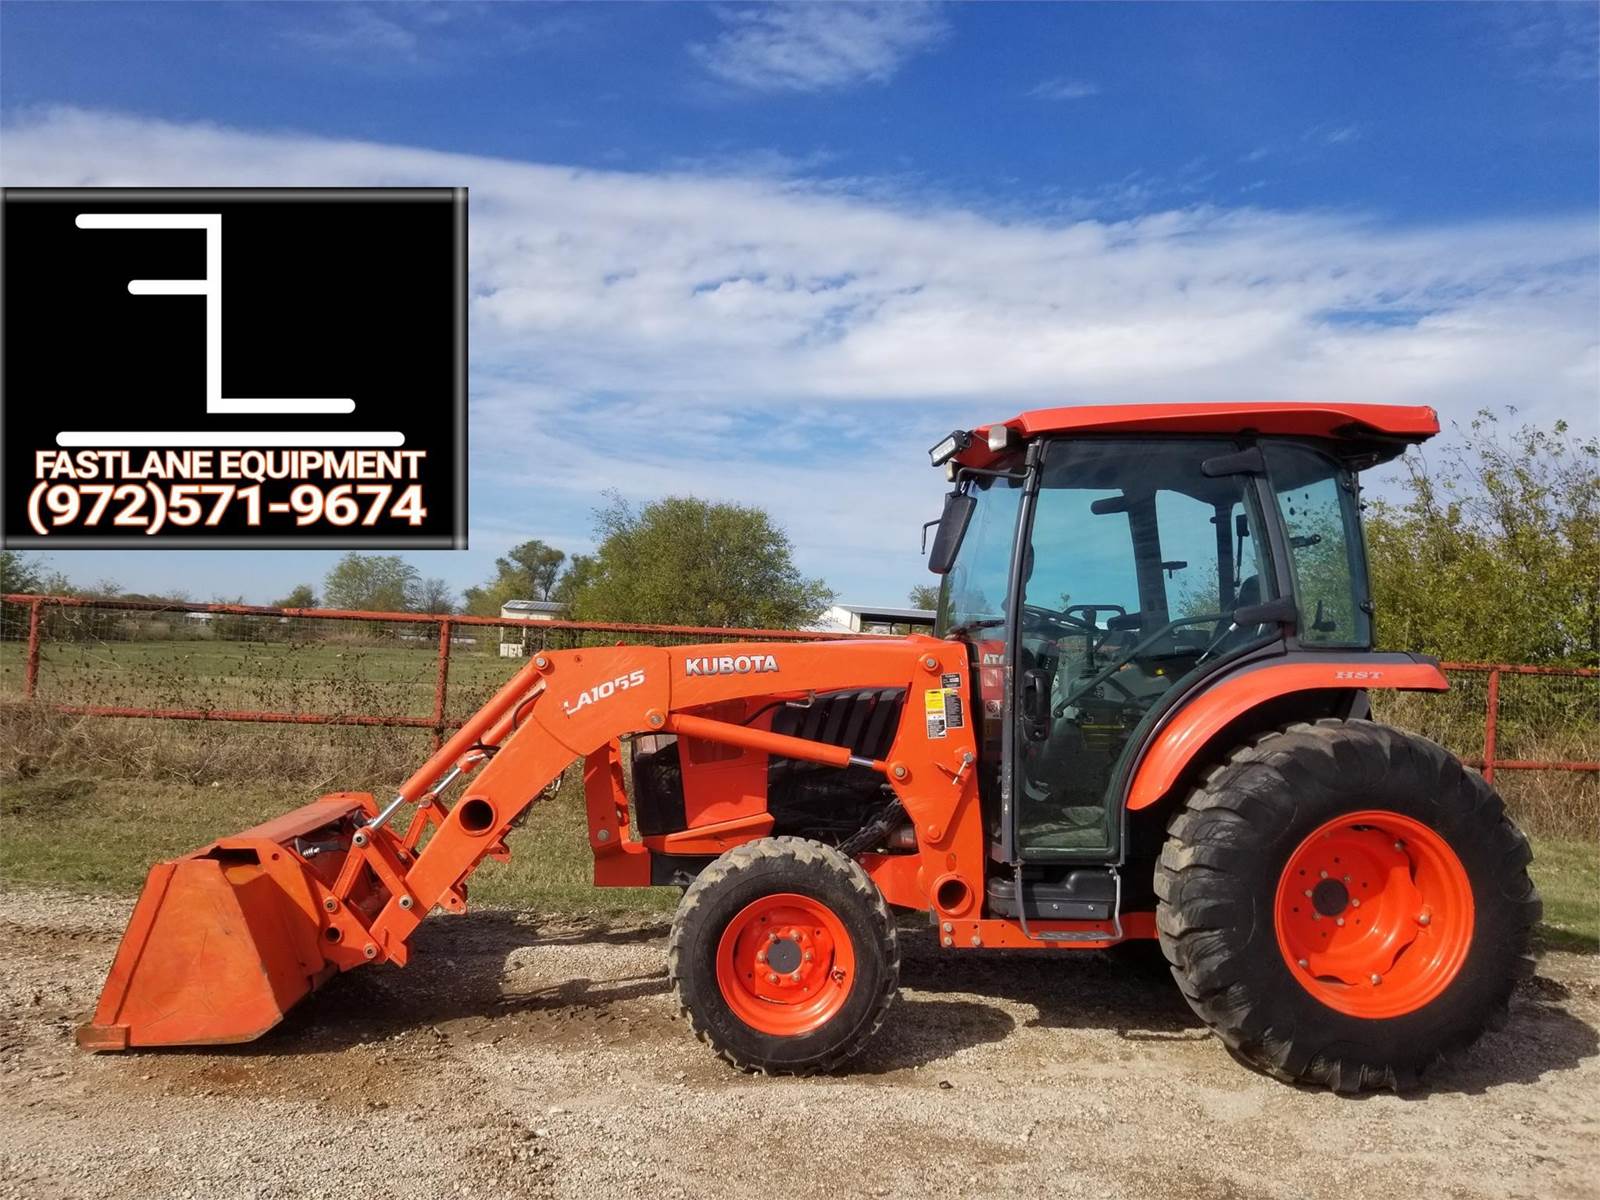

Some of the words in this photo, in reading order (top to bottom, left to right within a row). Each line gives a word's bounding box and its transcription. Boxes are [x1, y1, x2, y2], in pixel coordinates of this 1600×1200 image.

[686, 655, 779, 676] KUBOTA
[1336, 671, 1383, 679] HST
[563, 669, 646, 715] LA1055
